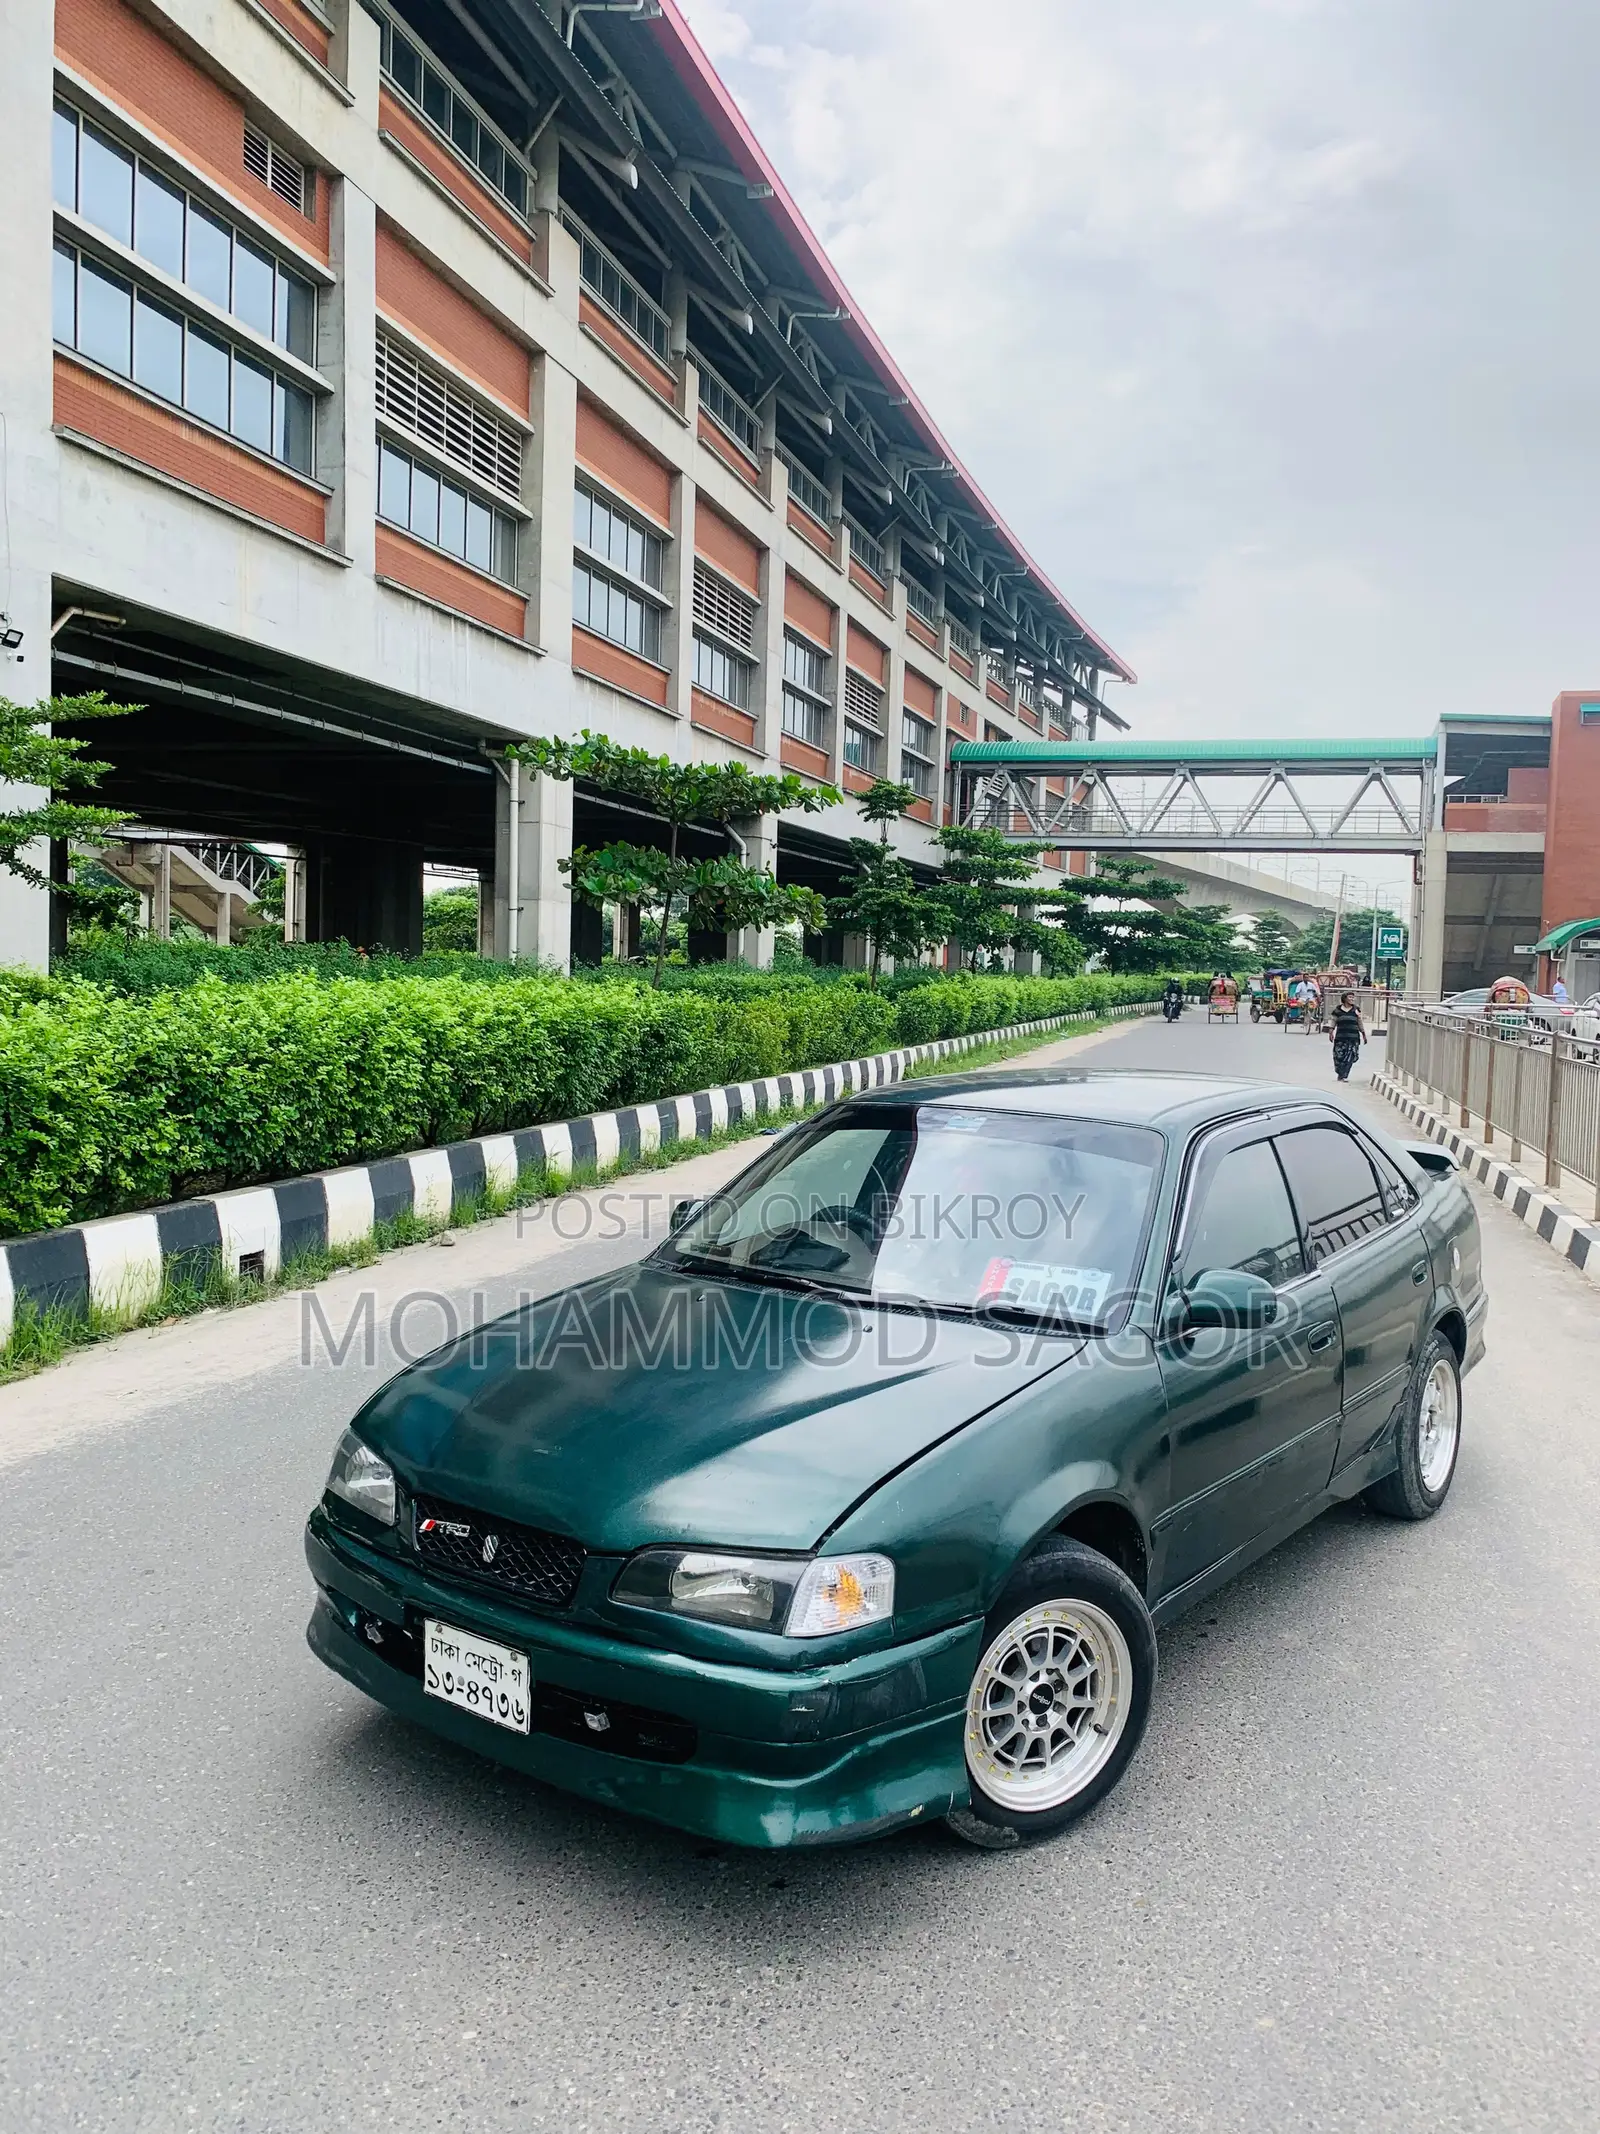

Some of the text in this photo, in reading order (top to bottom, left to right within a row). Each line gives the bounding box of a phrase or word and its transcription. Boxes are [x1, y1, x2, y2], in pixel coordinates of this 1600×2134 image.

[1009, 1276, 1098, 1313] SAGOR
[430, 1637, 460, 1663] ঢাকা
[427, 1663, 525, 1725] ১৩-৪৭৩৬
